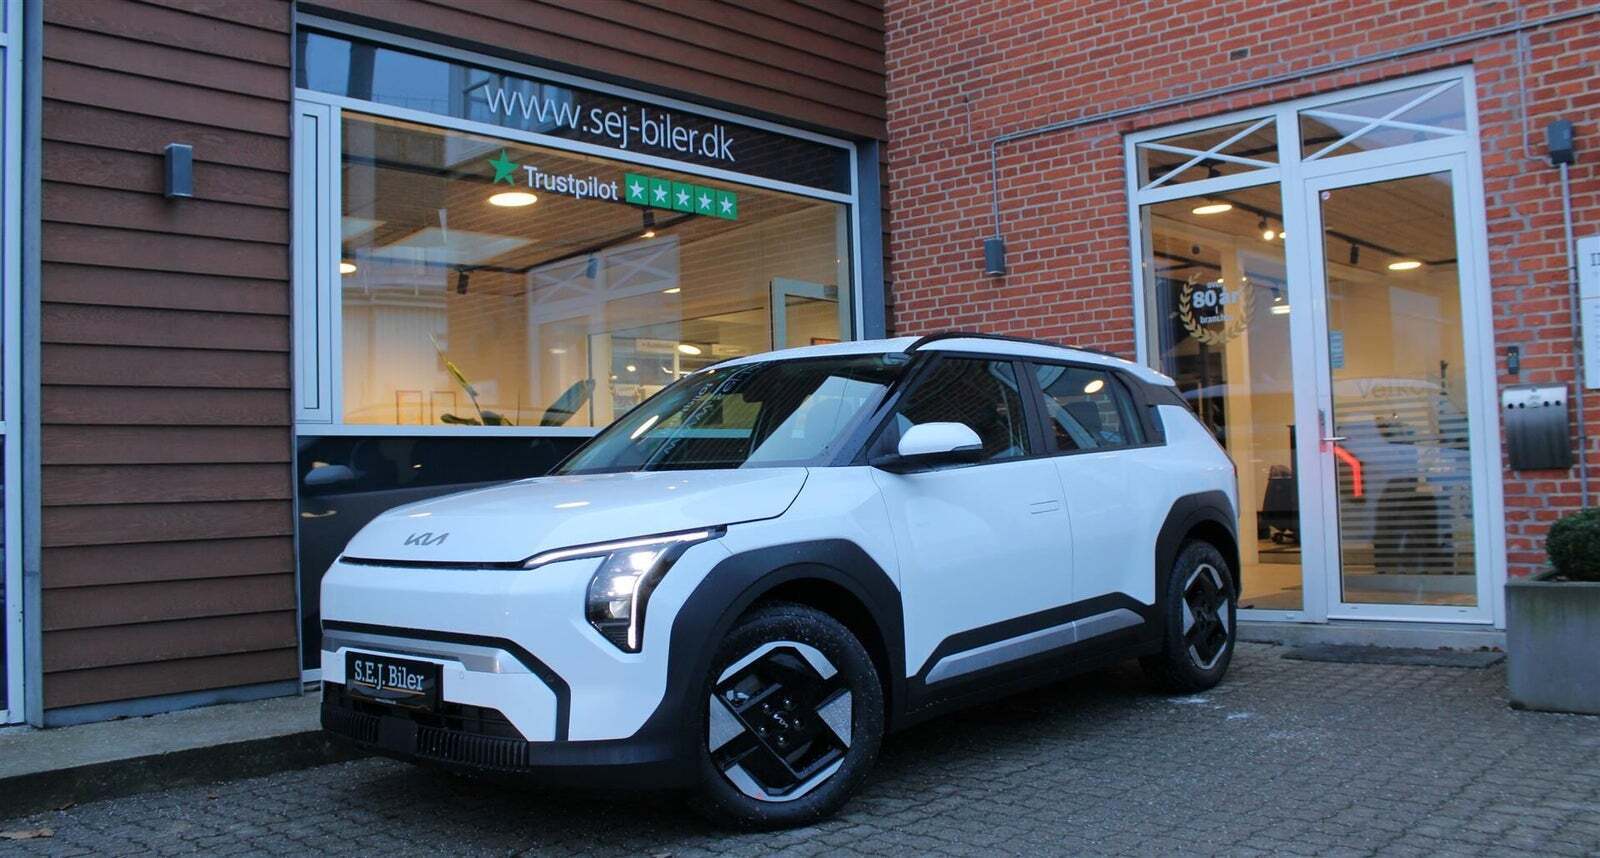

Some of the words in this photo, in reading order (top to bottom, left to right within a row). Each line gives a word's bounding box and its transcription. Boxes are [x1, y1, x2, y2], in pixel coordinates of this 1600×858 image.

[484, 84, 736, 162] www.sej-biler.dk
[523, 164, 619, 200] Trustpilot
[1192, 289, 1217, 309] 80
[403, 532, 449, 546] KIA
[354, 659, 386, 690] S.E.J.
[388, 664, 424, 691] Biler
